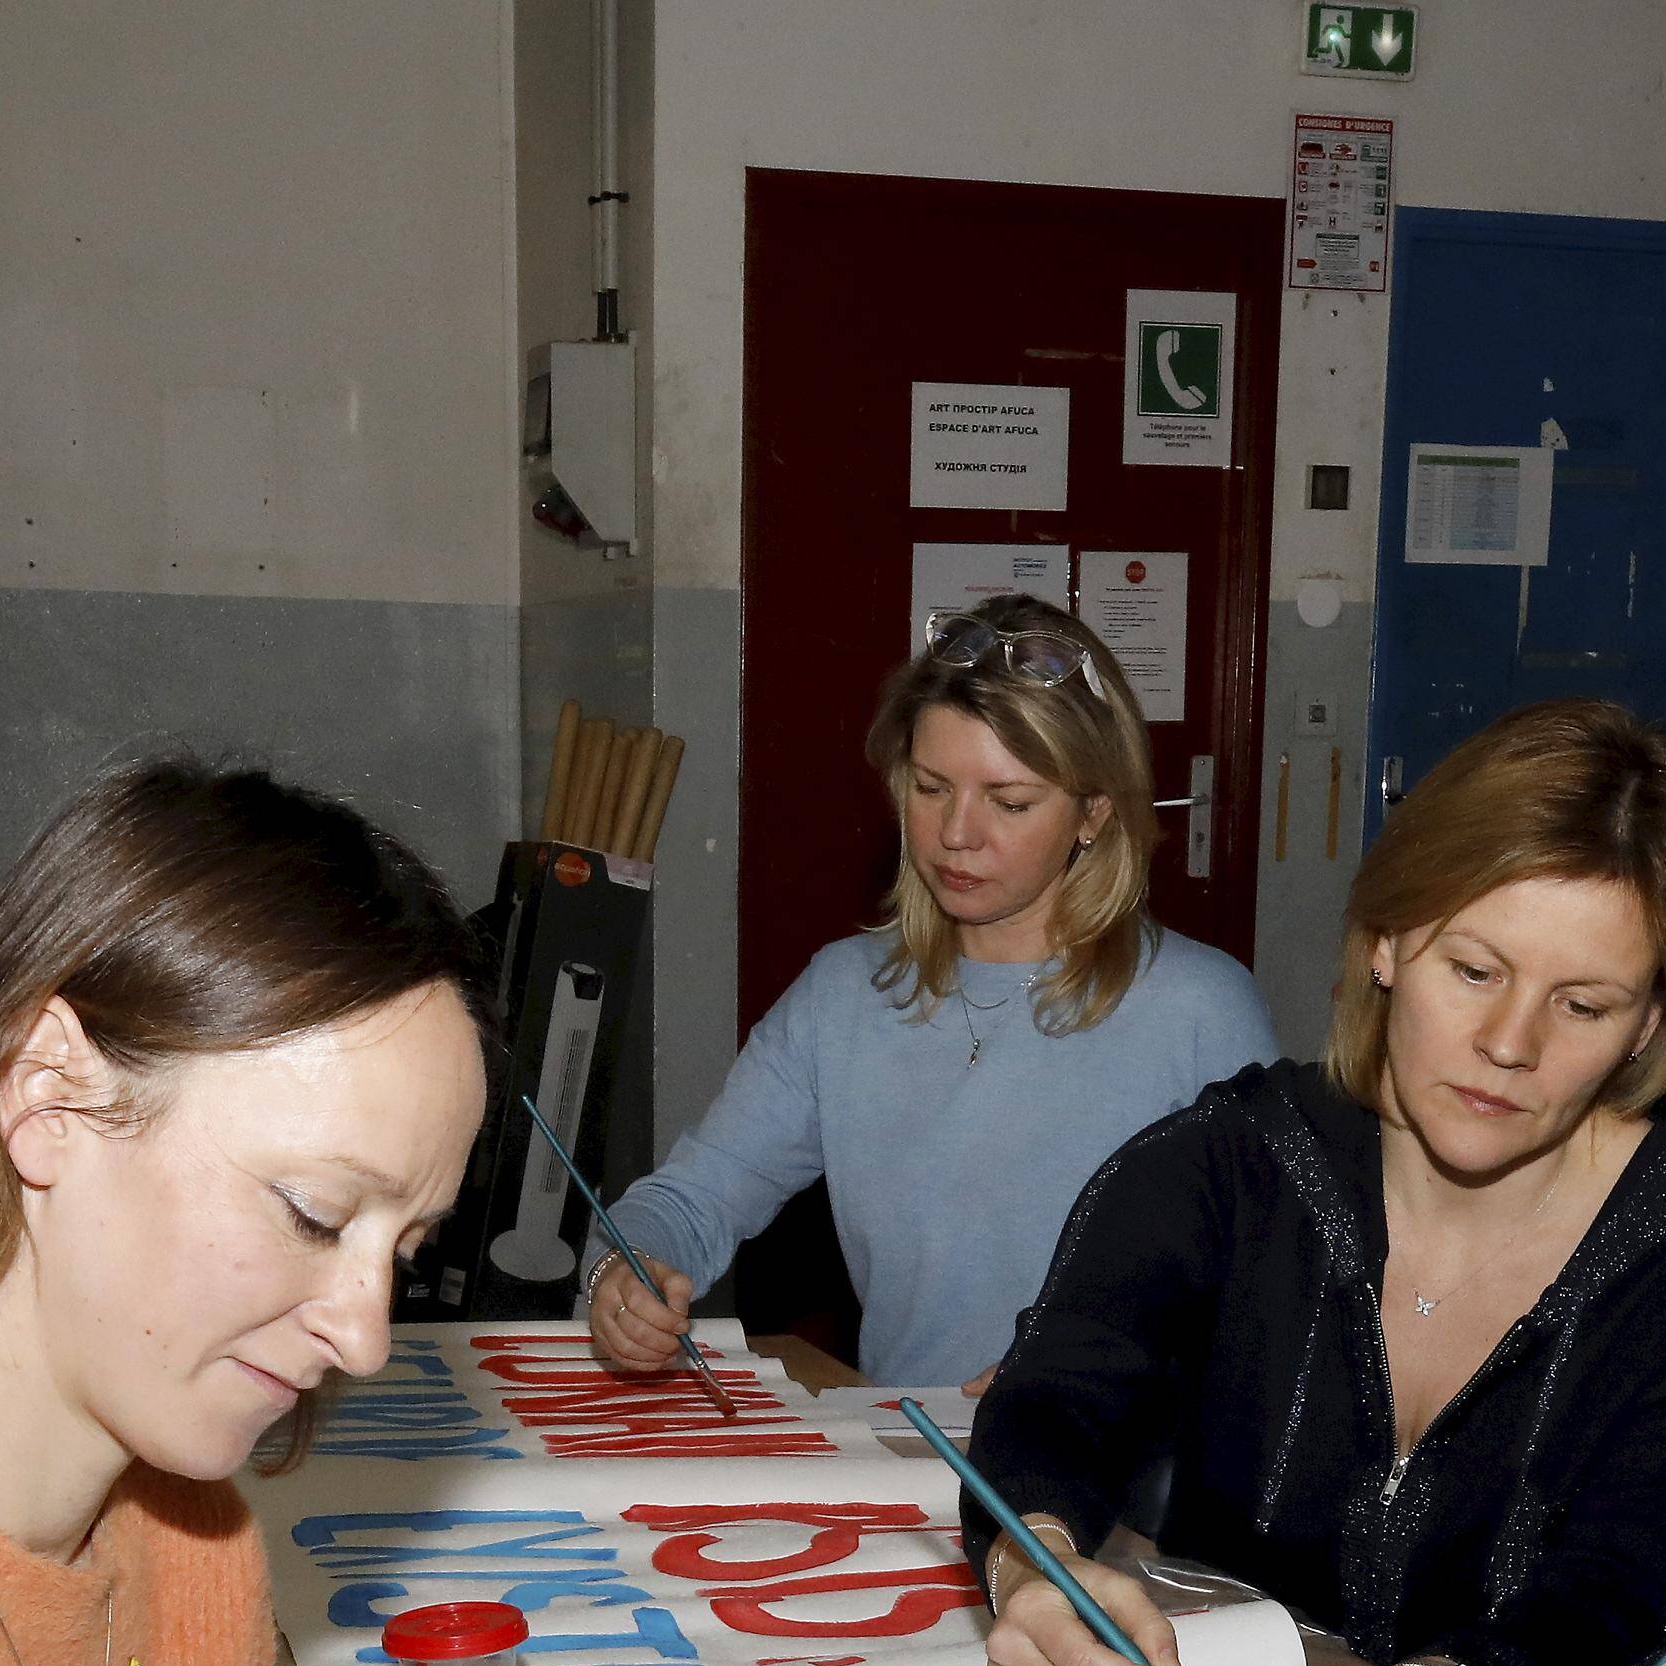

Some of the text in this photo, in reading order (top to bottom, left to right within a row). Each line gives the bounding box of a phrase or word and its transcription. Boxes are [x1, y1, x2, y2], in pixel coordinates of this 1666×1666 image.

[1298, 118, 1390, 132] CONSIGNES D'URGENCE
[929, 404, 950, 412] ART
[1001, 407, 1035, 416] AFUCA
[929, 423, 1039, 435] ESPACE D'ART AFUCA
[935, 462, 1027, 475] ХУДОЖНЯ СТУДІЯ
